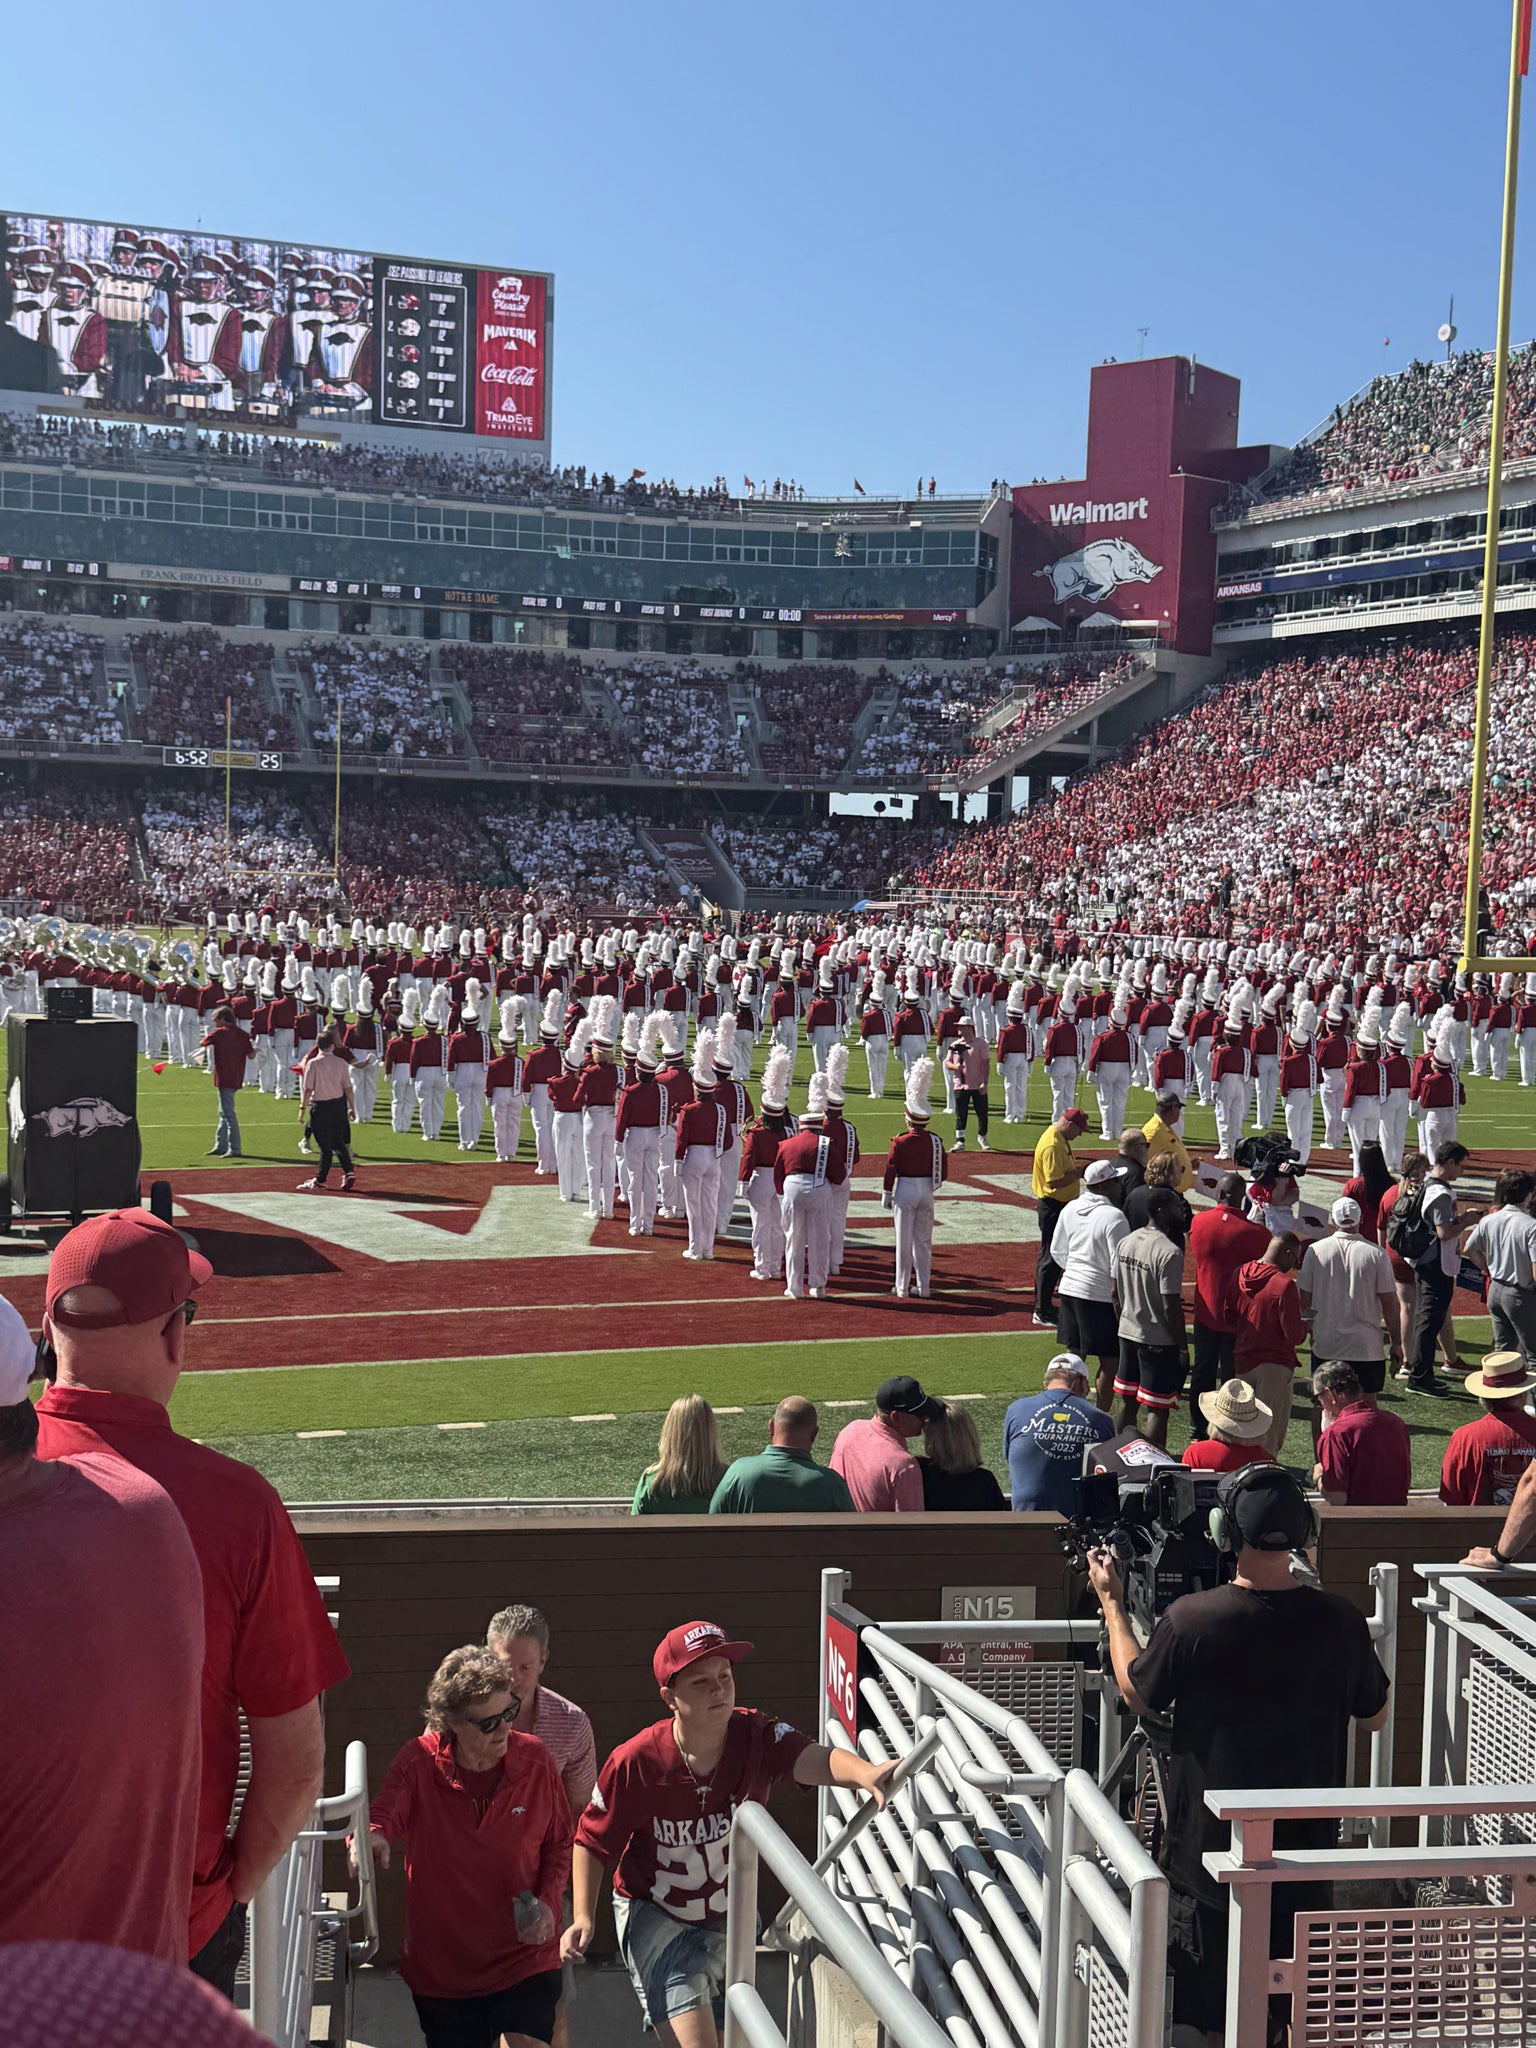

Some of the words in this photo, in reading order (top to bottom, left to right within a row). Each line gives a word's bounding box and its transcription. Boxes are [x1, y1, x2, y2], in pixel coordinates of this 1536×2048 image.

[484, 324, 536, 348] MAVERIK
[1050, 497, 1148, 527] Walmart
[89, 562, 99, 576] 10
[140, 568, 177, 580] FRANK
[180, 573, 229, 584] BROYLES
[232, 577, 262, 587] FIELD
[1217, 580, 1263, 598] ARKANSAS
[445, 590, 472, 602] NOTRE
[475, 593, 499, 604] DAME
[556, 597, 562, 609] 0
[615, 601, 621, 613] 0
[673, 604, 680, 616] 0
[739, 607, 745, 619] 0
[779, 609, 801, 621] 00:00
[933, 612, 952, 622] Mercy
[176, 750, 208, 765] 6:52
[261, 754, 279, 769] 25
[1021, 1417, 1100, 1439] MASTERS
[1033, 1432, 1094, 1444] TOURNAMENT
[1050, 1442, 1076, 1453] 2025
[963, 1595, 1014, 1620] N15
[981, 1641, 1011, 1650] entral,
[1014, 1641, 1032, 1649] Inc.
[948, 1653, 955, 1661] A
[982, 1653, 1026, 1664] Company
[828, 1636, 855, 1722] NF6
[653, 1803, 737, 1846] ARKANS
